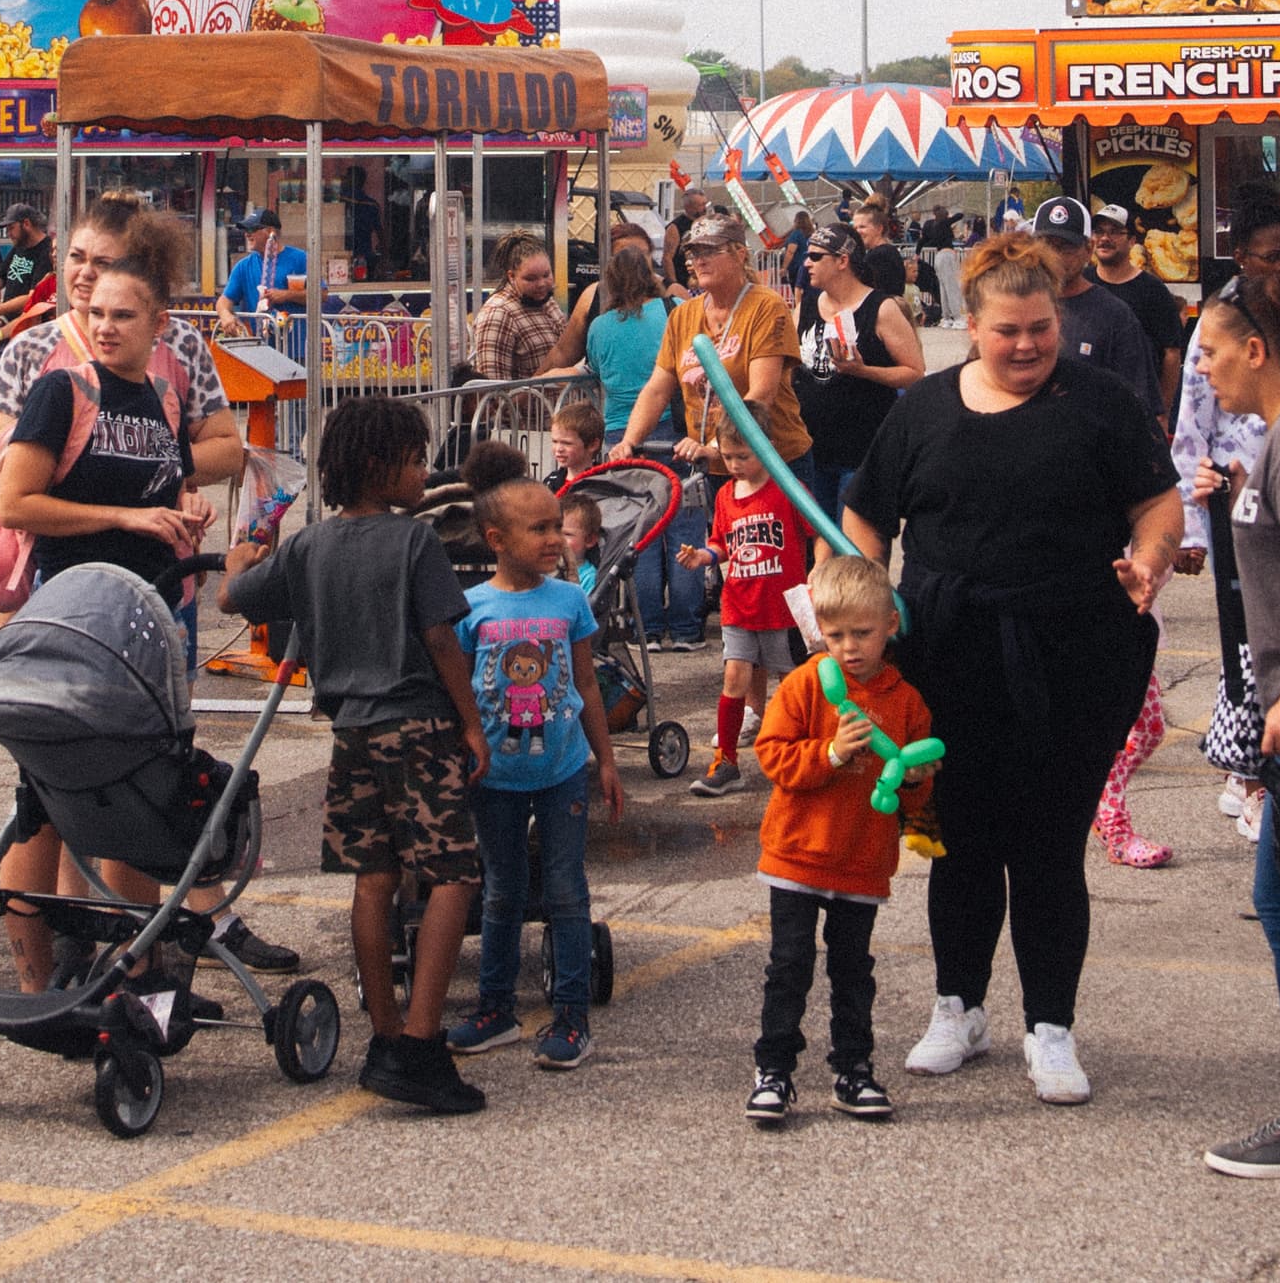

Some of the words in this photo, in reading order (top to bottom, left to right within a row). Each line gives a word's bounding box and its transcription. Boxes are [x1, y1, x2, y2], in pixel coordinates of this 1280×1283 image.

[154, 6, 179, 33] POP
[208, 11, 232, 34] POP
[1181, 45, 1272, 59] FRESH-CUT
[1069, 60, 1254, 97] FRENCH
[370, 63, 577, 129] TORNADO
[653, 114, 677, 142] Sky
[1109, 127, 1142, 137] DEEP
[1144, 126, 1179, 138] FRIED
[1096, 134, 1192, 158] PICKLES
[478, 619, 568, 645] PRINCESS
